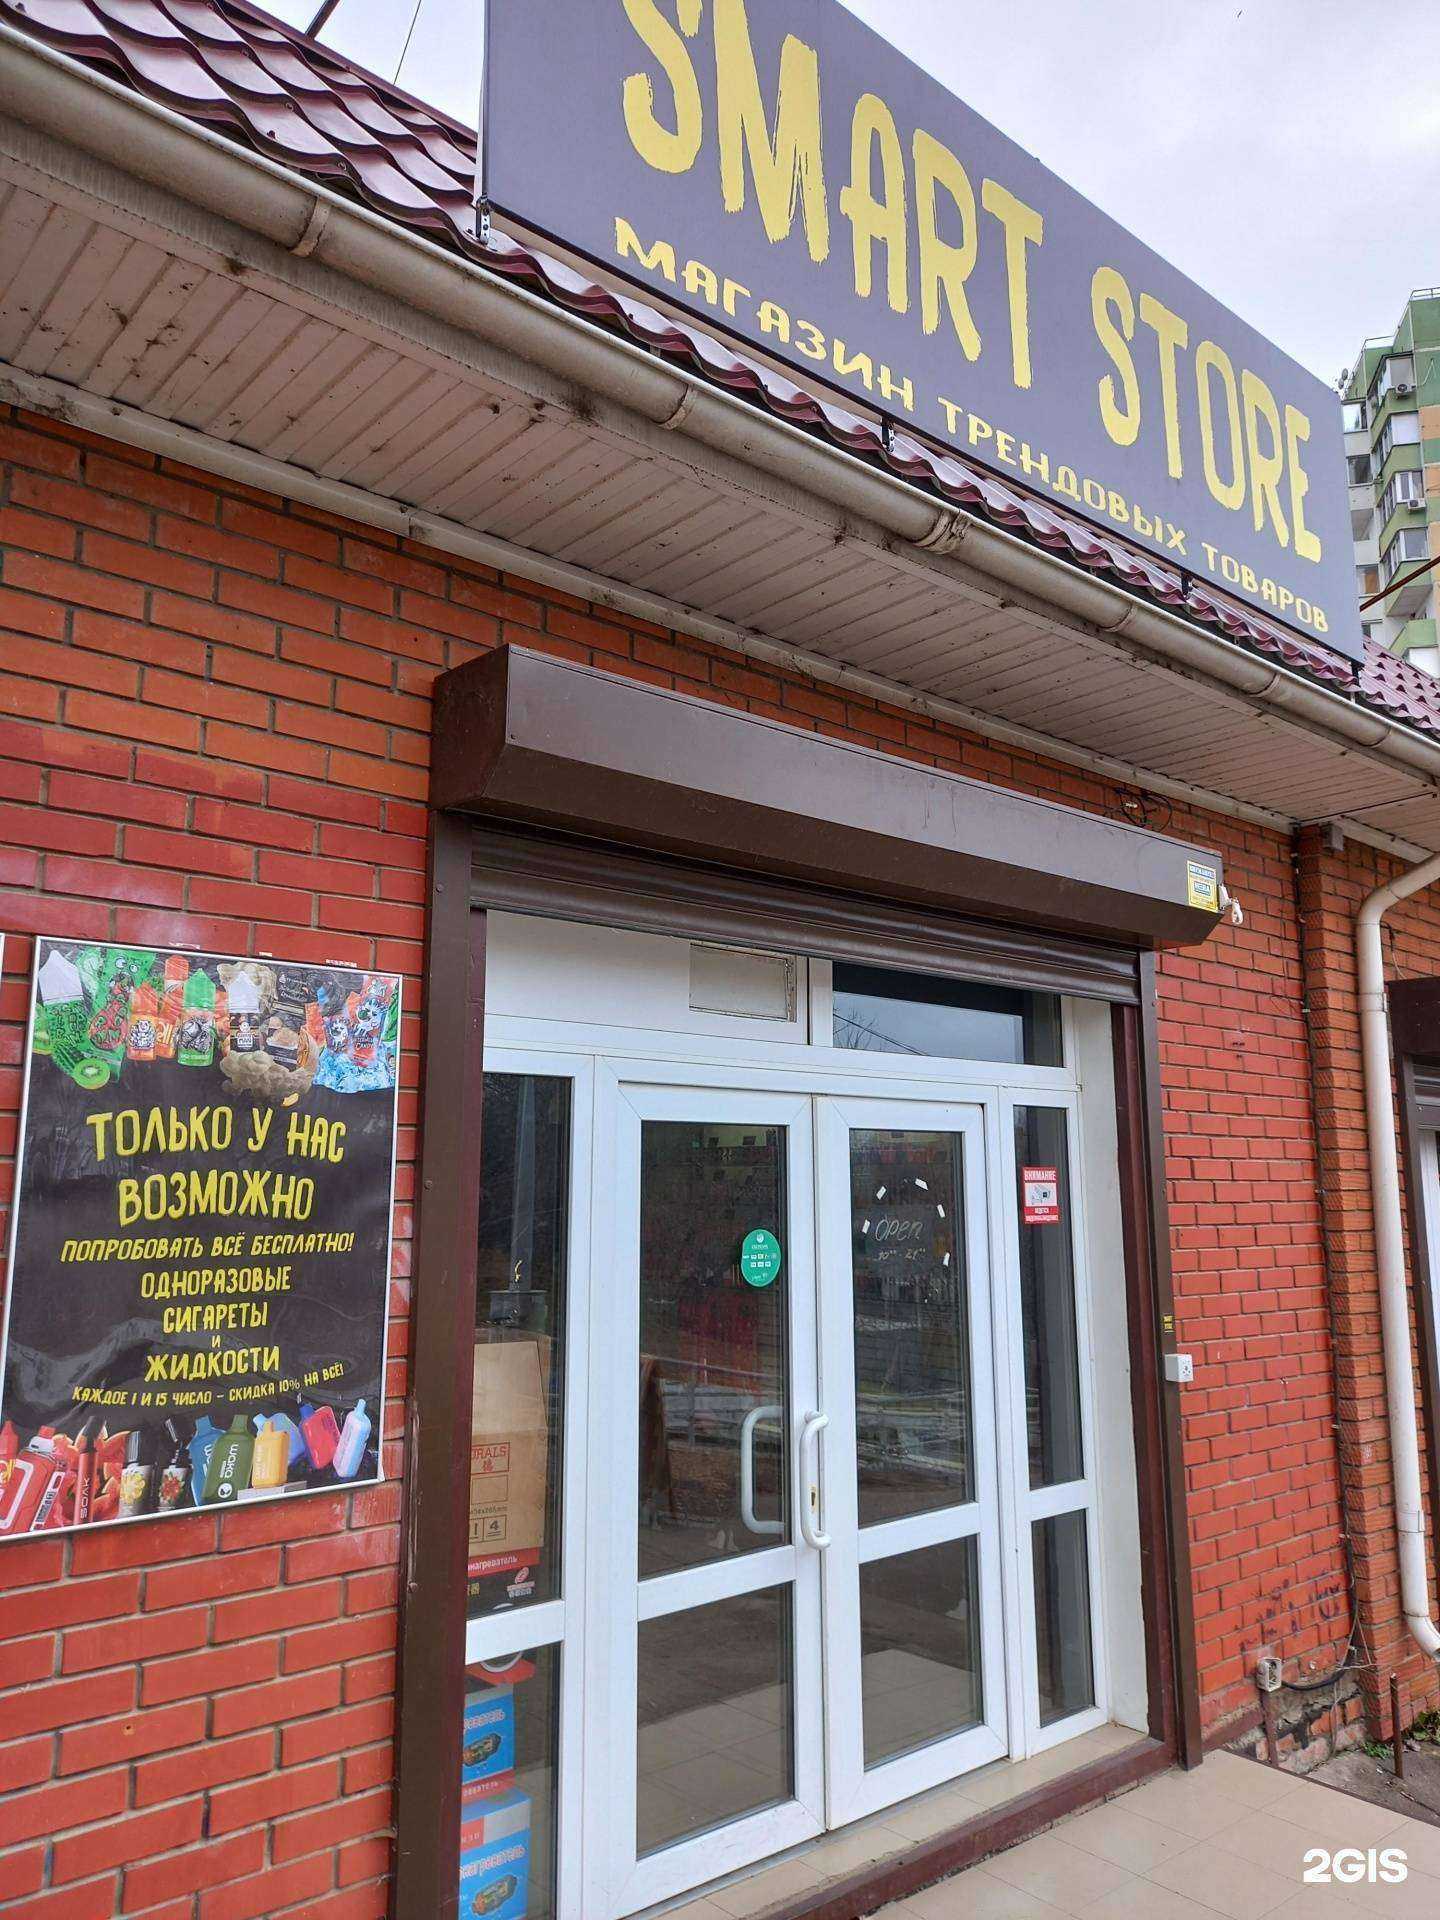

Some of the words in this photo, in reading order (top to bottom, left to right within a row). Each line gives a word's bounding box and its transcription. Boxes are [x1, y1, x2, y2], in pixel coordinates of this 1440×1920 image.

[623, 0, 1044, 389] SMART
[1091, 266, 1322, 564] STORE
[614, 216, 915, 412] МАГАЗИН
[937, 396, 1188, 556] ТРЕНДОВЫХ
[1201, 542, 1329, 633] ТОВАРОВ
[86, 1105, 233, 1162] ТОЛЬКО
[247, 1106, 273, 1153] У
[286, 1111, 346, 1164] НАС
[118, 1169, 315, 1228] ВОЗМОЖНО
[875, 1215, 923, 1241] Open
[60, 1236, 203, 1263] ПОПРОБОВАТЬ
[210, 1232, 245, 1257] ВСЁ
[250, 1232, 355, 1256] БЕСПЛАТНО!
[140, 1265, 292, 1300] ОДНОРАЗОВЫЕ
[163, 1301, 268, 1334] СИГАРЕТЫ
[144, 1345, 280, 1383] ЖИДКОСТИ
[71, 1385, 128, 1407] КАЖДОЕ
[155, 1391, 168, 1407] 15
[171, 1389, 213, 1406] ЧИСЛО
[228, 1383, 275, 1403] СКИДКА
[304, 1372, 319, 1388] НА
